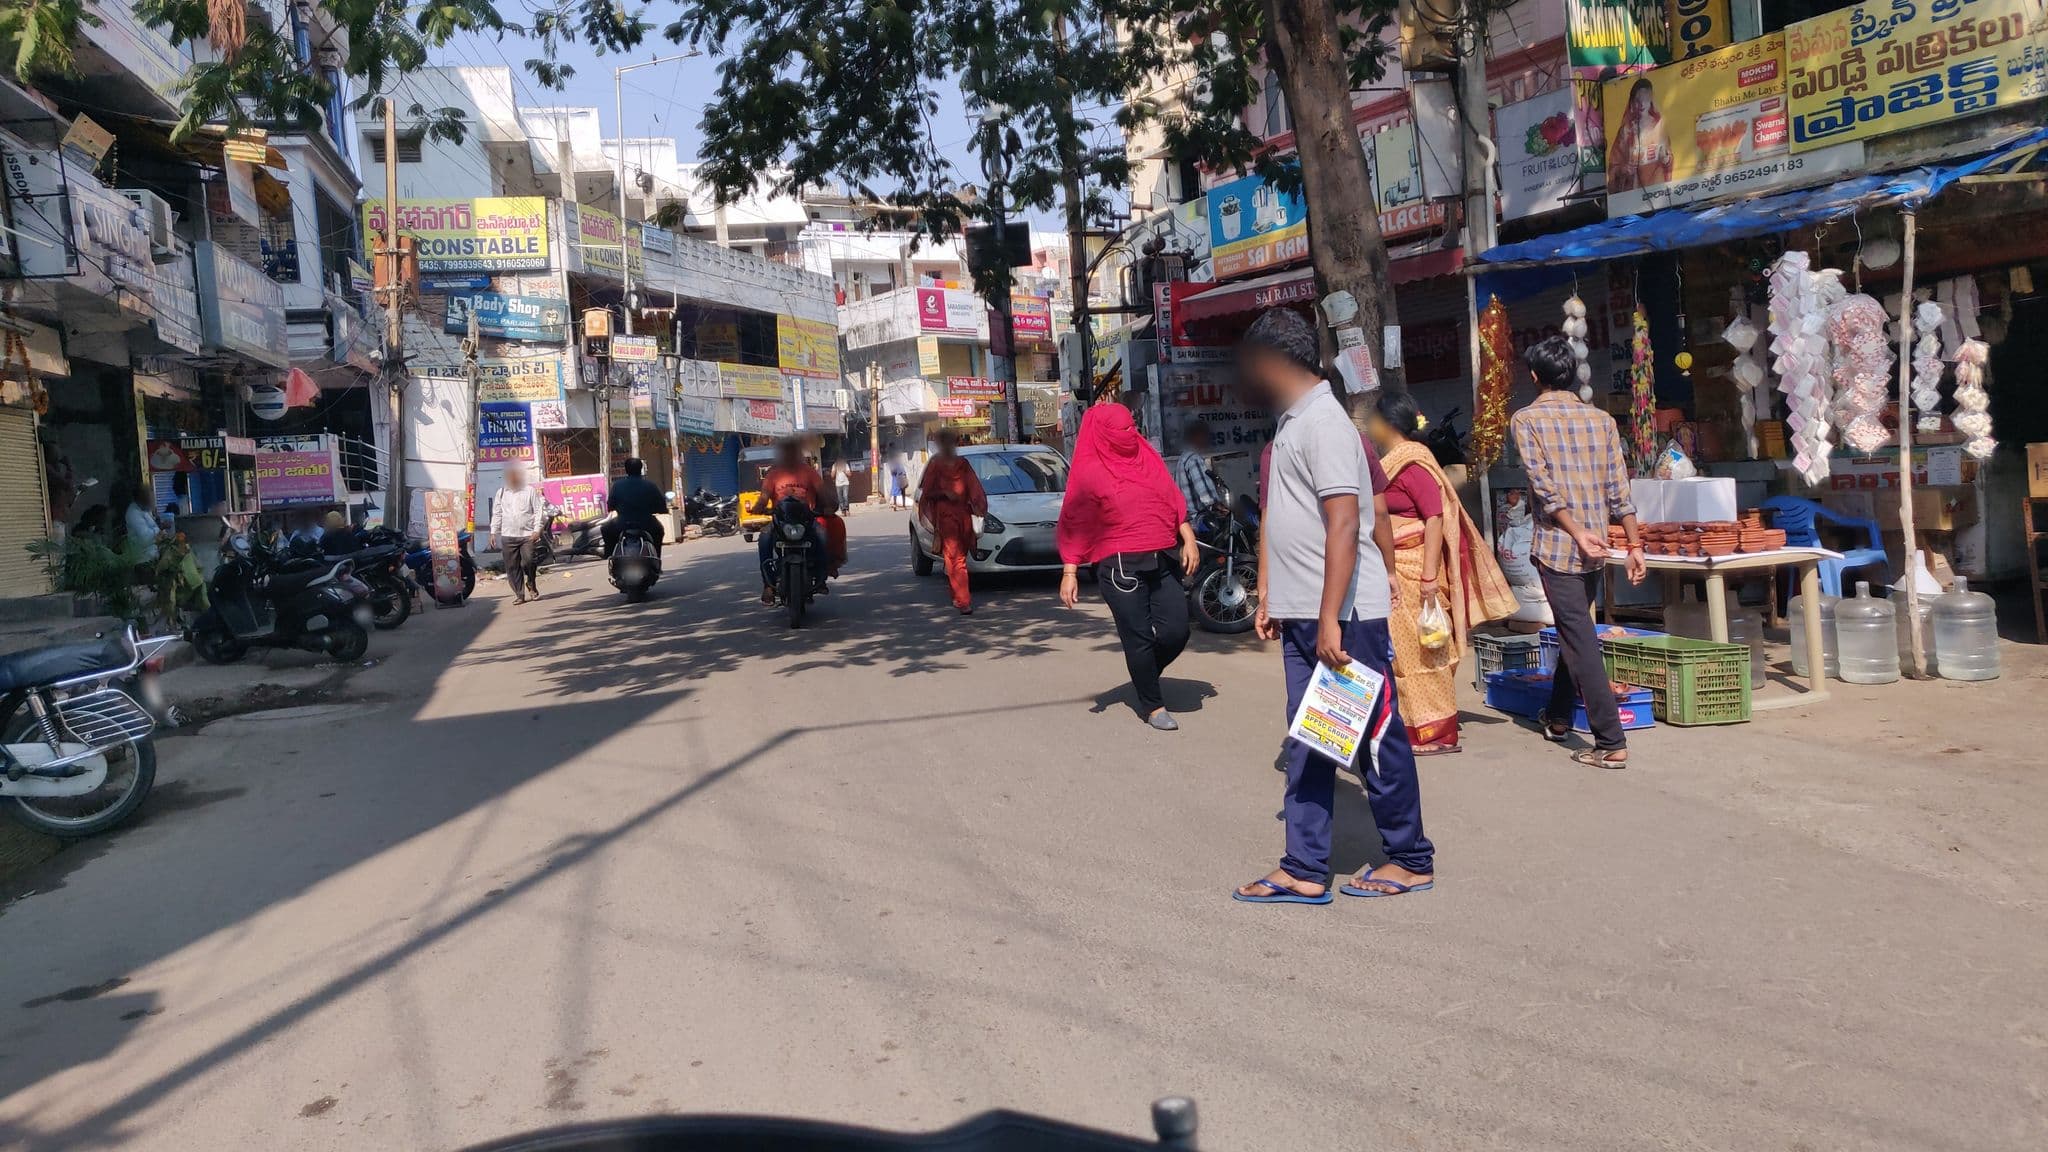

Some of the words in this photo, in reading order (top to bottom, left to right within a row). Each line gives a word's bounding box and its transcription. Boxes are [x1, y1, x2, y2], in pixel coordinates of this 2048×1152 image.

[1741, 63, 1774, 78] MOKSH
[1522, 159, 1549, 176] FRUIT
[1558, 152, 1577, 168] LOO
[1724, 158, 1803, 184] 9652494183
[417, 236, 539, 256] CONSTABLE
[1248, 244, 1271, 267] SAI
[1276, 235, 1309, 260] RAM
[1255, 290, 1272, 304] SAI
[1274, 286, 1297, 301] RAM
[1300, 281, 1316, 296] ST
[474, 294, 505, 315] Body
[508, 298, 540, 318] Shop
[488, 419, 527, 434] FINANCE
[1198, 411, 1237, 421] STRONG
[180, 438, 207, 449] ALLAM
[207, 437, 224, 448] TEA
[489, 447, 497, 459] &
[500, 446, 531, 459] GOLD
[1304, 714, 1327, 729] APPSC
[1327, 726, 1349, 740] GROUP
